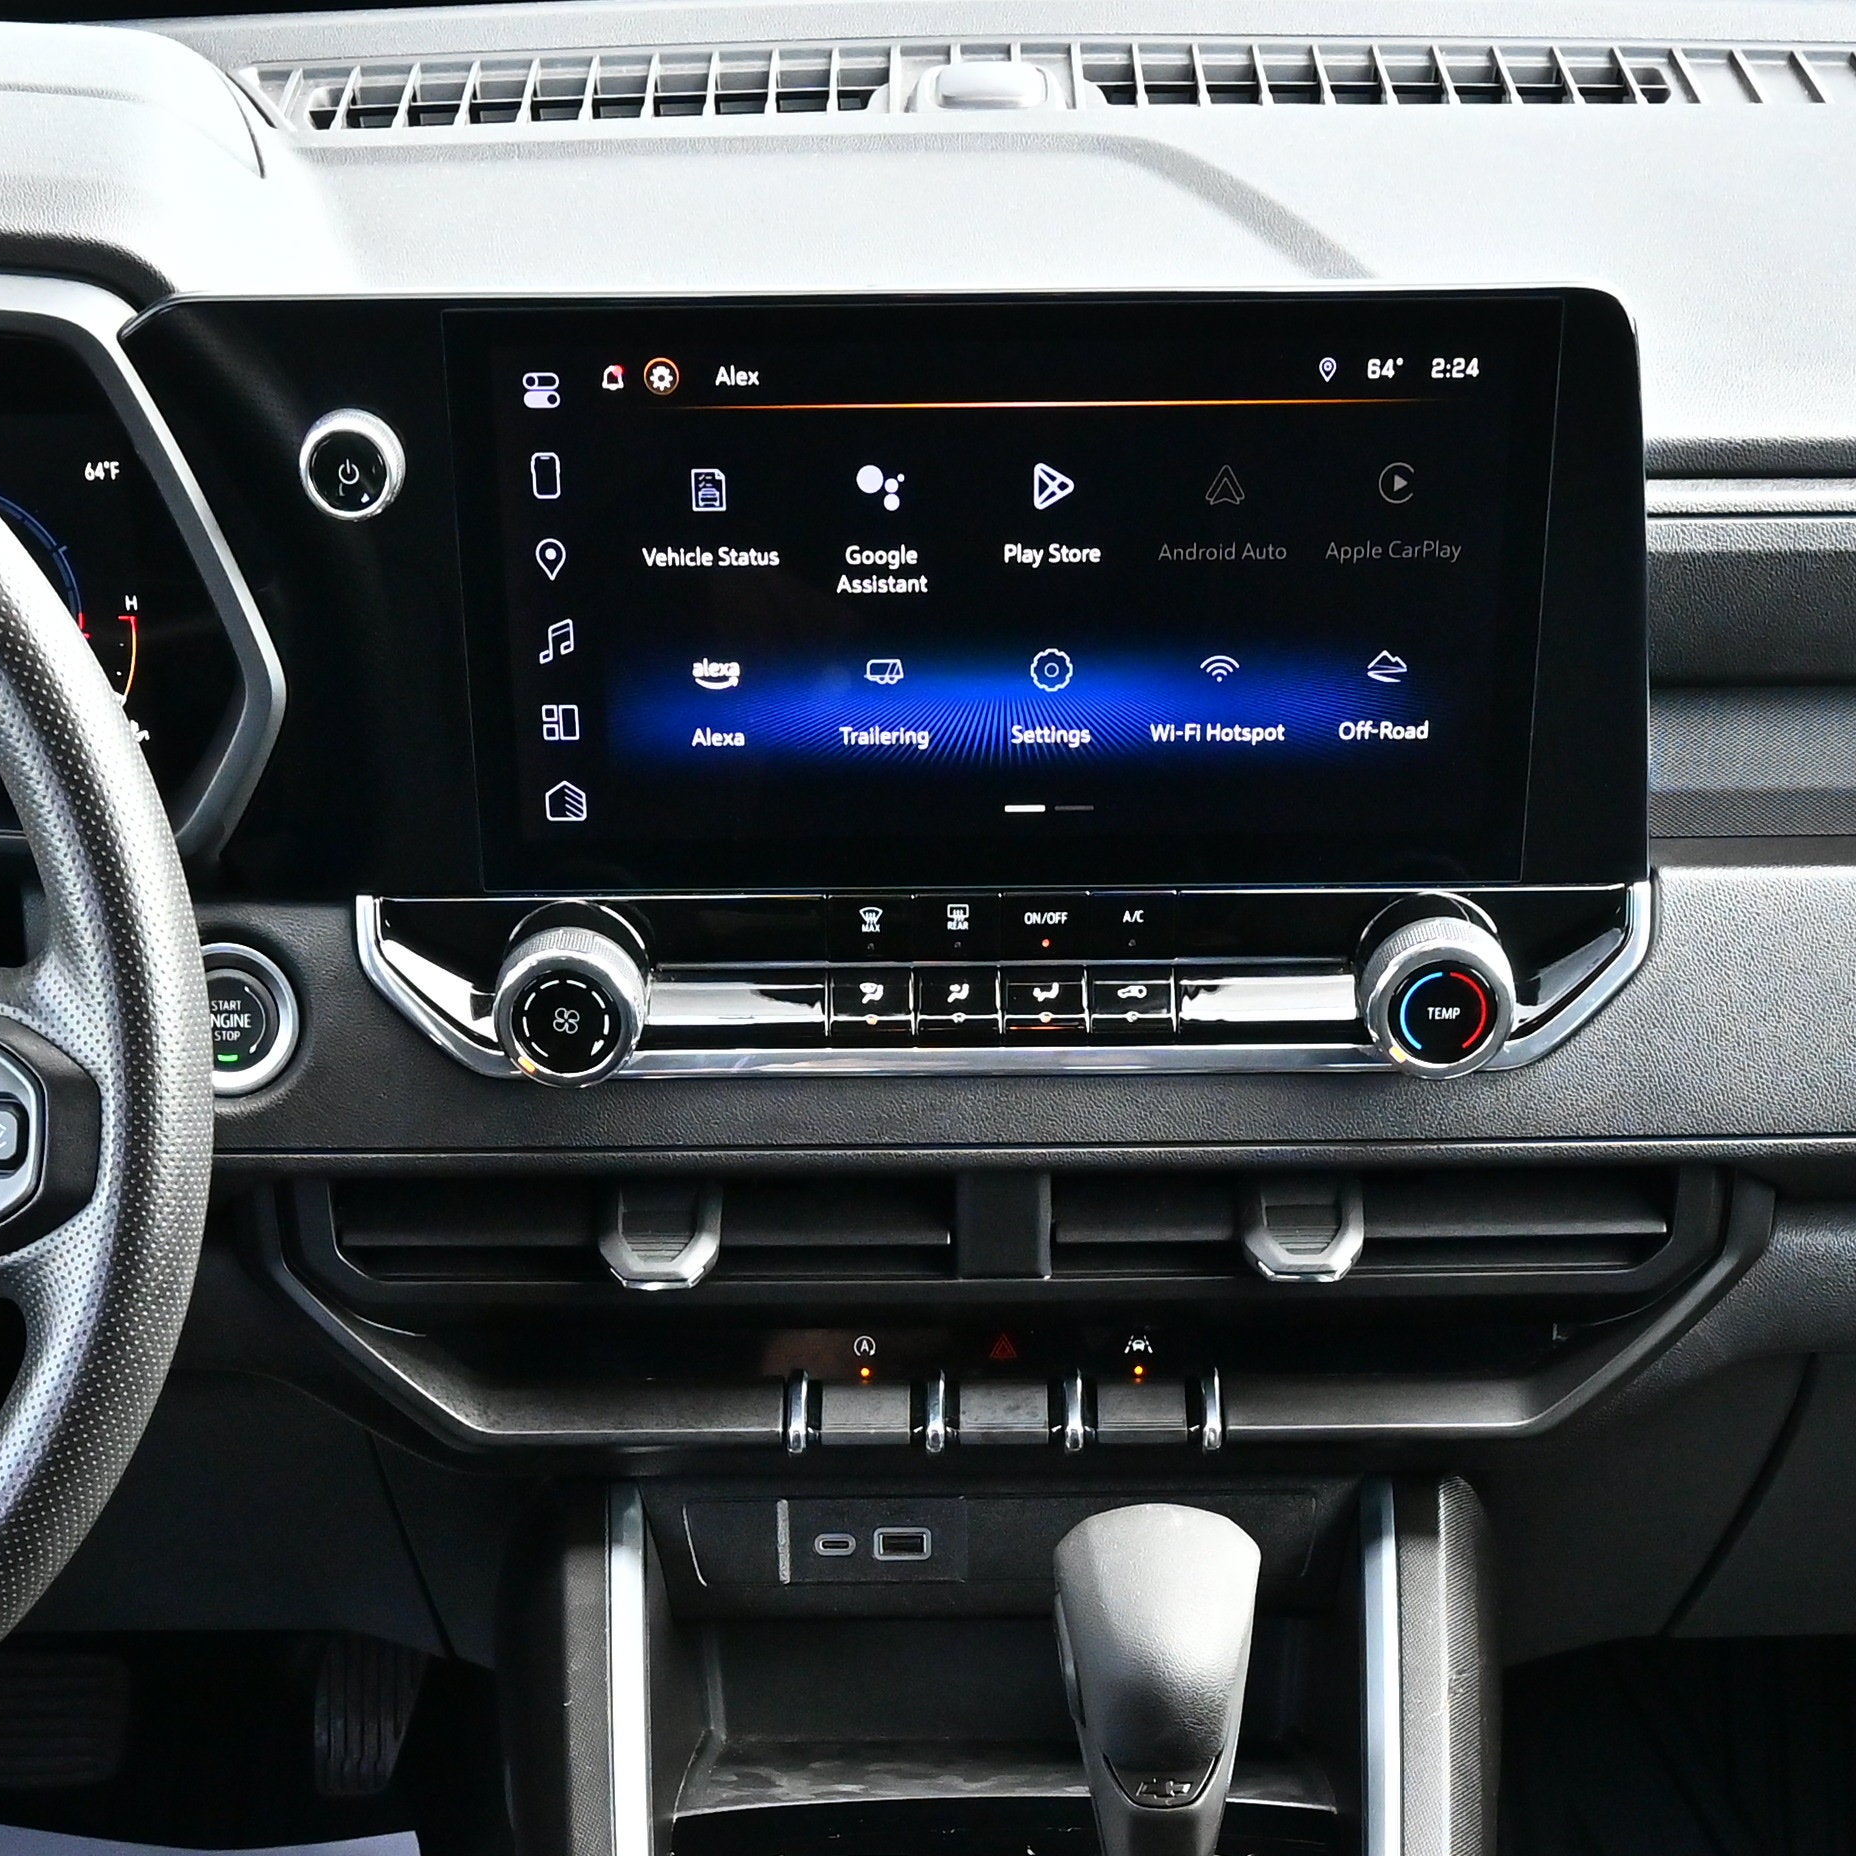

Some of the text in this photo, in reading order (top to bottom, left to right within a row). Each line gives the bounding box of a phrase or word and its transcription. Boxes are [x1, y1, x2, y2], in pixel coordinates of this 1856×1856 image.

[715, 366, 760, 387] Alex
[1367, 357, 1480, 379] 64° 2:24
[84, 460, 120, 481] 64°F
[642, 547, 780, 567] Vehicle Status
[845, 545, 918, 569] Google
[1003, 543, 1101, 568] Play Store
[1158, 542, 1287, 561] Android Auto
[1325, 540, 1462, 564] Apple CarPlay
[836, 575, 928, 594] Assistant
[692, 657, 740, 677] alexa
[691, 728, 745, 747] Alexa
[839, 726, 931, 750] Trailering
[1010, 724, 1091, 748] Settings
[1149, 723, 1286, 746] Wi-Fi Hotspot
[1338, 720, 1429, 741] Off-Road
[947, 920, 969, 931] REAR
[1024, 911, 1068, 925] ON/OFF
[1122, 910, 1144, 923] A/C
[861, 923, 881, 933] MAX
[211, 1000, 241, 1011] START
[1427, 1007, 1461, 1020] TEMP
[210, 1013, 252, 1028] NGINE
[214, 1031, 241, 1041] STOP
